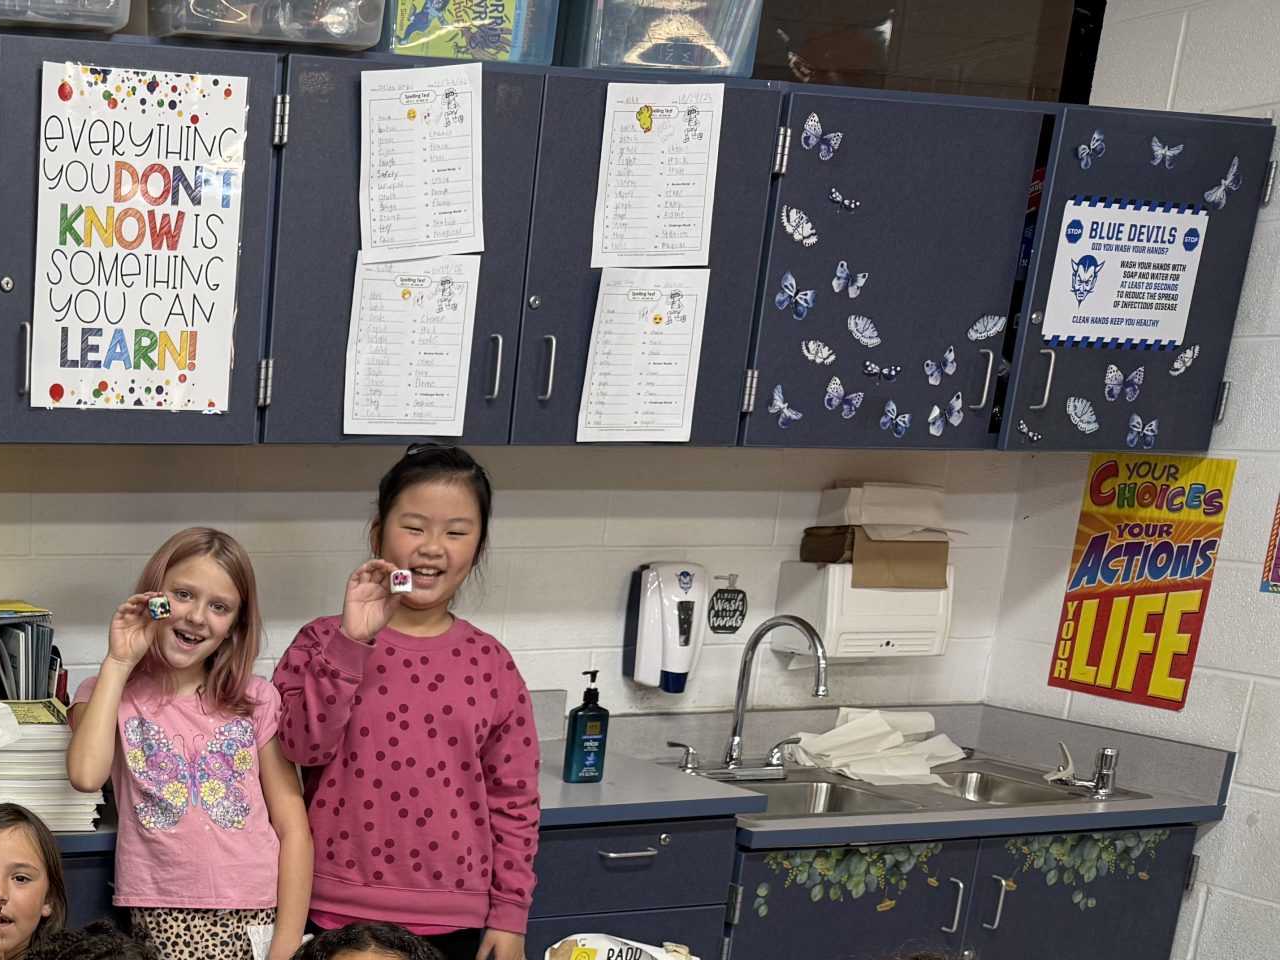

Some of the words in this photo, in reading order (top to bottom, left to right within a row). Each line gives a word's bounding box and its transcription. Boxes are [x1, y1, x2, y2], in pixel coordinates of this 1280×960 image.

[58, 203, 186, 251] KNOW
[193, 213, 224, 250] IS
[1067, 228, 1082, 236] STOP
[1089, 221, 1125, 241] BLUE
[1128, 224, 1178, 245] DEVILS
[1103, 243, 1114, 252] YOU
[1115, 244, 1131, 253] WASH
[1132, 246, 1146, 254] YOUR
[1146, 247, 1169, 256] HANDS?
[1120, 260, 1137, 269] WASH
[1137, 261, 1152, 269] YOUR
[1153, 262, 1170, 271] HANDS
[1171, 264, 1187, 272] WITH
[1123, 271, 1138, 279] SOAP
[1138, 272, 1150, 280] AND
[1150, 272, 1168, 281] WATER
[1128, 281, 1145, 289] LEAST
[1145, 282, 1153, 290] 20
[1153, 283, 1178, 291] SECONDS
[1124, 291, 1145, 300] REDUCE
[1146, 292, 1157, 301] THE
[1157, 293, 1179, 301] SPREAD
[139, 293, 215, 327] CAN
[1121, 301, 1154, 310] INFECTIOUS
[1154, 302, 1178, 311] DISEASE
[1072, 316, 1090, 324] CLEAN
[1090, 316, 1109, 325] HANDS
[1110, 317, 1124, 326] KEEP
[1136, 319, 1160, 327] HEALTHY
[59, 326, 198, 372] LEARN!
[1125, 461, 1180, 482] YOUR
[1089, 460, 1224, 517] CHOICES
[1116, 522, 1174, 539] YOUR
[1067, 533, 1219, 592] ACTIONS
[710, 610, 743, 627] hands
[1053, 601, 1078, 679] YOUR
[1069, 589, 1203, 702] LIFE
